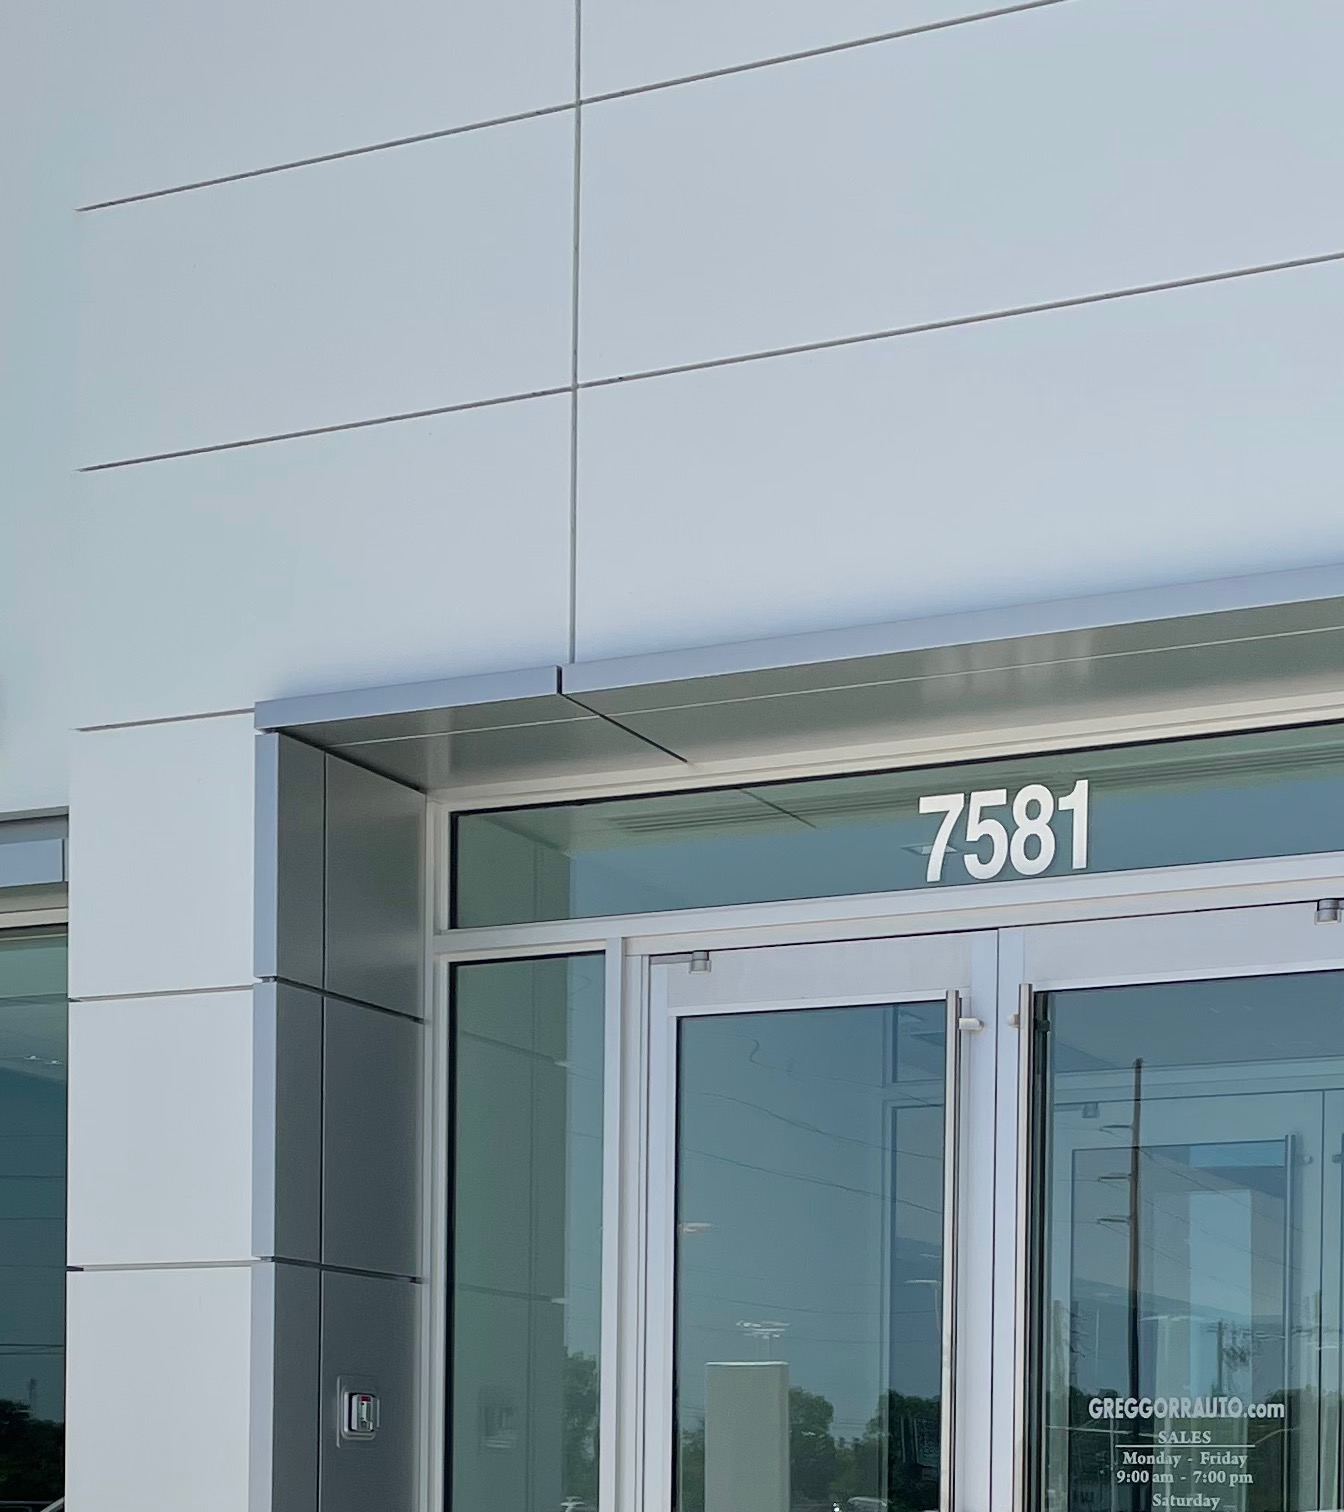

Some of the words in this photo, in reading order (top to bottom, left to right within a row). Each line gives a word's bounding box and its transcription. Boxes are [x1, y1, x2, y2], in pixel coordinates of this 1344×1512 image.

[918, 779, 1090, 883] 7581
[1088, 1396, 1285, 1420] GREGGORRAUTO.com
[1158, 1430, 1211, 1444] SALES
[1122, 1451, 1182, 1468] Monday
[1199, 1451, 1248, 1468] Friday
[1116, 1470, 1150, 1484] 9:00
[1152, 1473, 1174, 1484] am
[1192, 1470, 1226, 1484] 7:00
[1229, 1473, 1253, 1487] pm
[1152, 1493, 1220, 1510] Saturday
